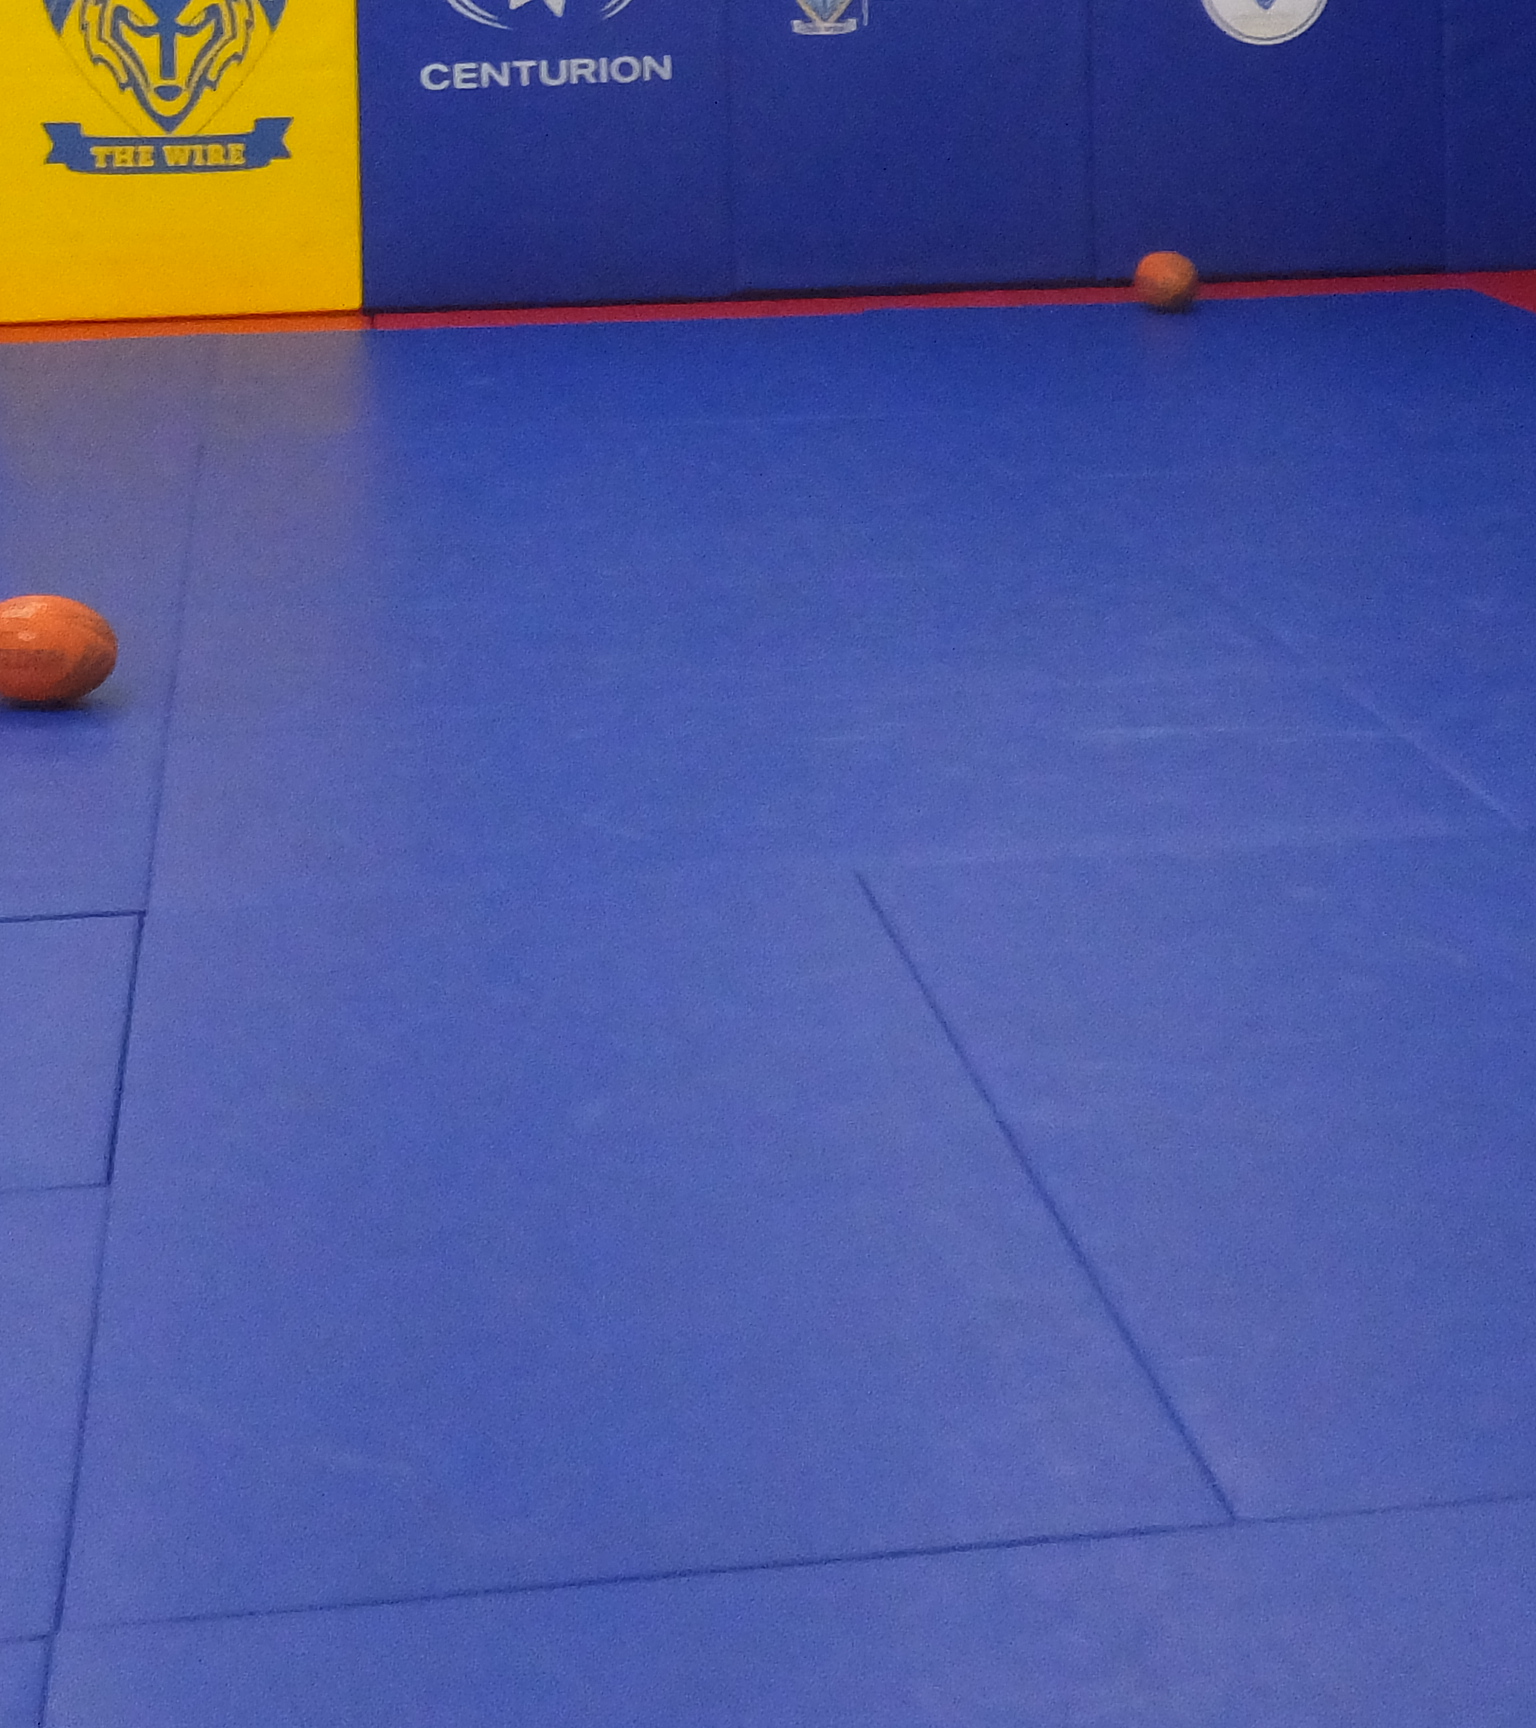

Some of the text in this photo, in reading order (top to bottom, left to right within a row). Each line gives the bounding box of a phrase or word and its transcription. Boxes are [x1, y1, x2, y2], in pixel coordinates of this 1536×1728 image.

[418, 55, 674, 91] CENTURION
[90, 143, 247, 168] THE WIRE
